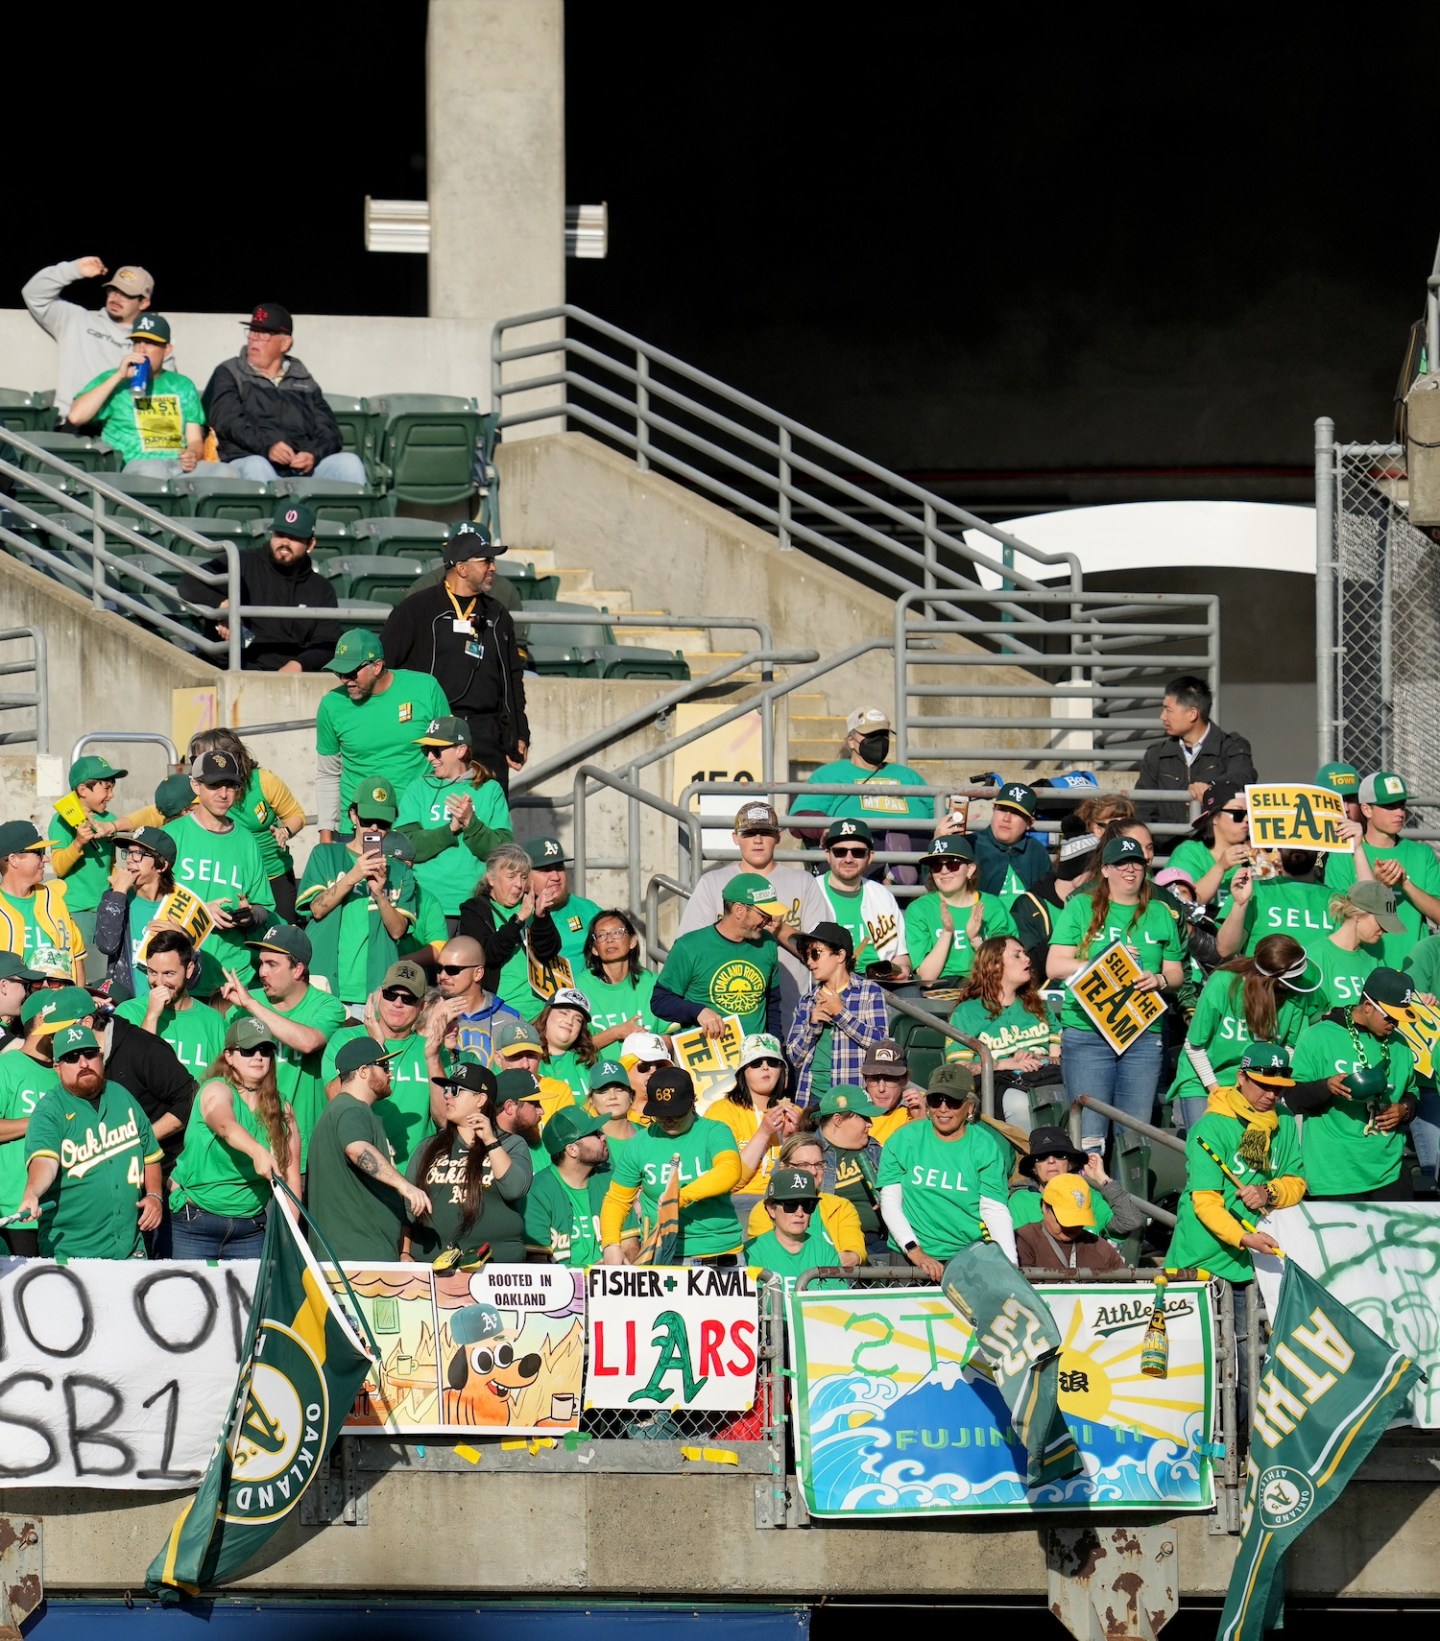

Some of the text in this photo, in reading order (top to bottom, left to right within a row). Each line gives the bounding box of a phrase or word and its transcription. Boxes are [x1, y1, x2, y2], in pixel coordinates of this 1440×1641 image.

[863, 796, 906, 811] MY PAL
[1252, 793, 1343, 812] SELL THE
[181, 859, 243, 889] SELL
[169, 889, 192, 922] THE
[1268, 906, 1334, 930] SELL
[715, 965, 763, 993] OAKLAND ROOTS
[1106, 952, 1158, 1020] SELL THE
[1335, 976, 1360, 999] SE
[1079, 969, 1139, 1046] TEAM
[718, 1021, 738, 1062] SELL
[387, 1059, 429, 1083] ELL
[681, 1032, 736, 1101] TEA
[655, 1087, 675, 1101] 68's
[60, 1109, 141, 1162] Oakland
[911, 1167, 968, 1191] SELL
[488, 1274, 552, 1287] ROOTED IN
[589, 1269, 663, 1297] FISHER
[688, 1270, 756, 1297] KAVAL
[495, 1293, 546, 1306] OAKLAND
[1092, 1298, 1190, 1330] Athleics
[594, 1310, 756, 1403] LIARS
[236, 1402, 321, 1511] OAKLAND
[1275, 1490, 1310, 1524] OAKLAND
